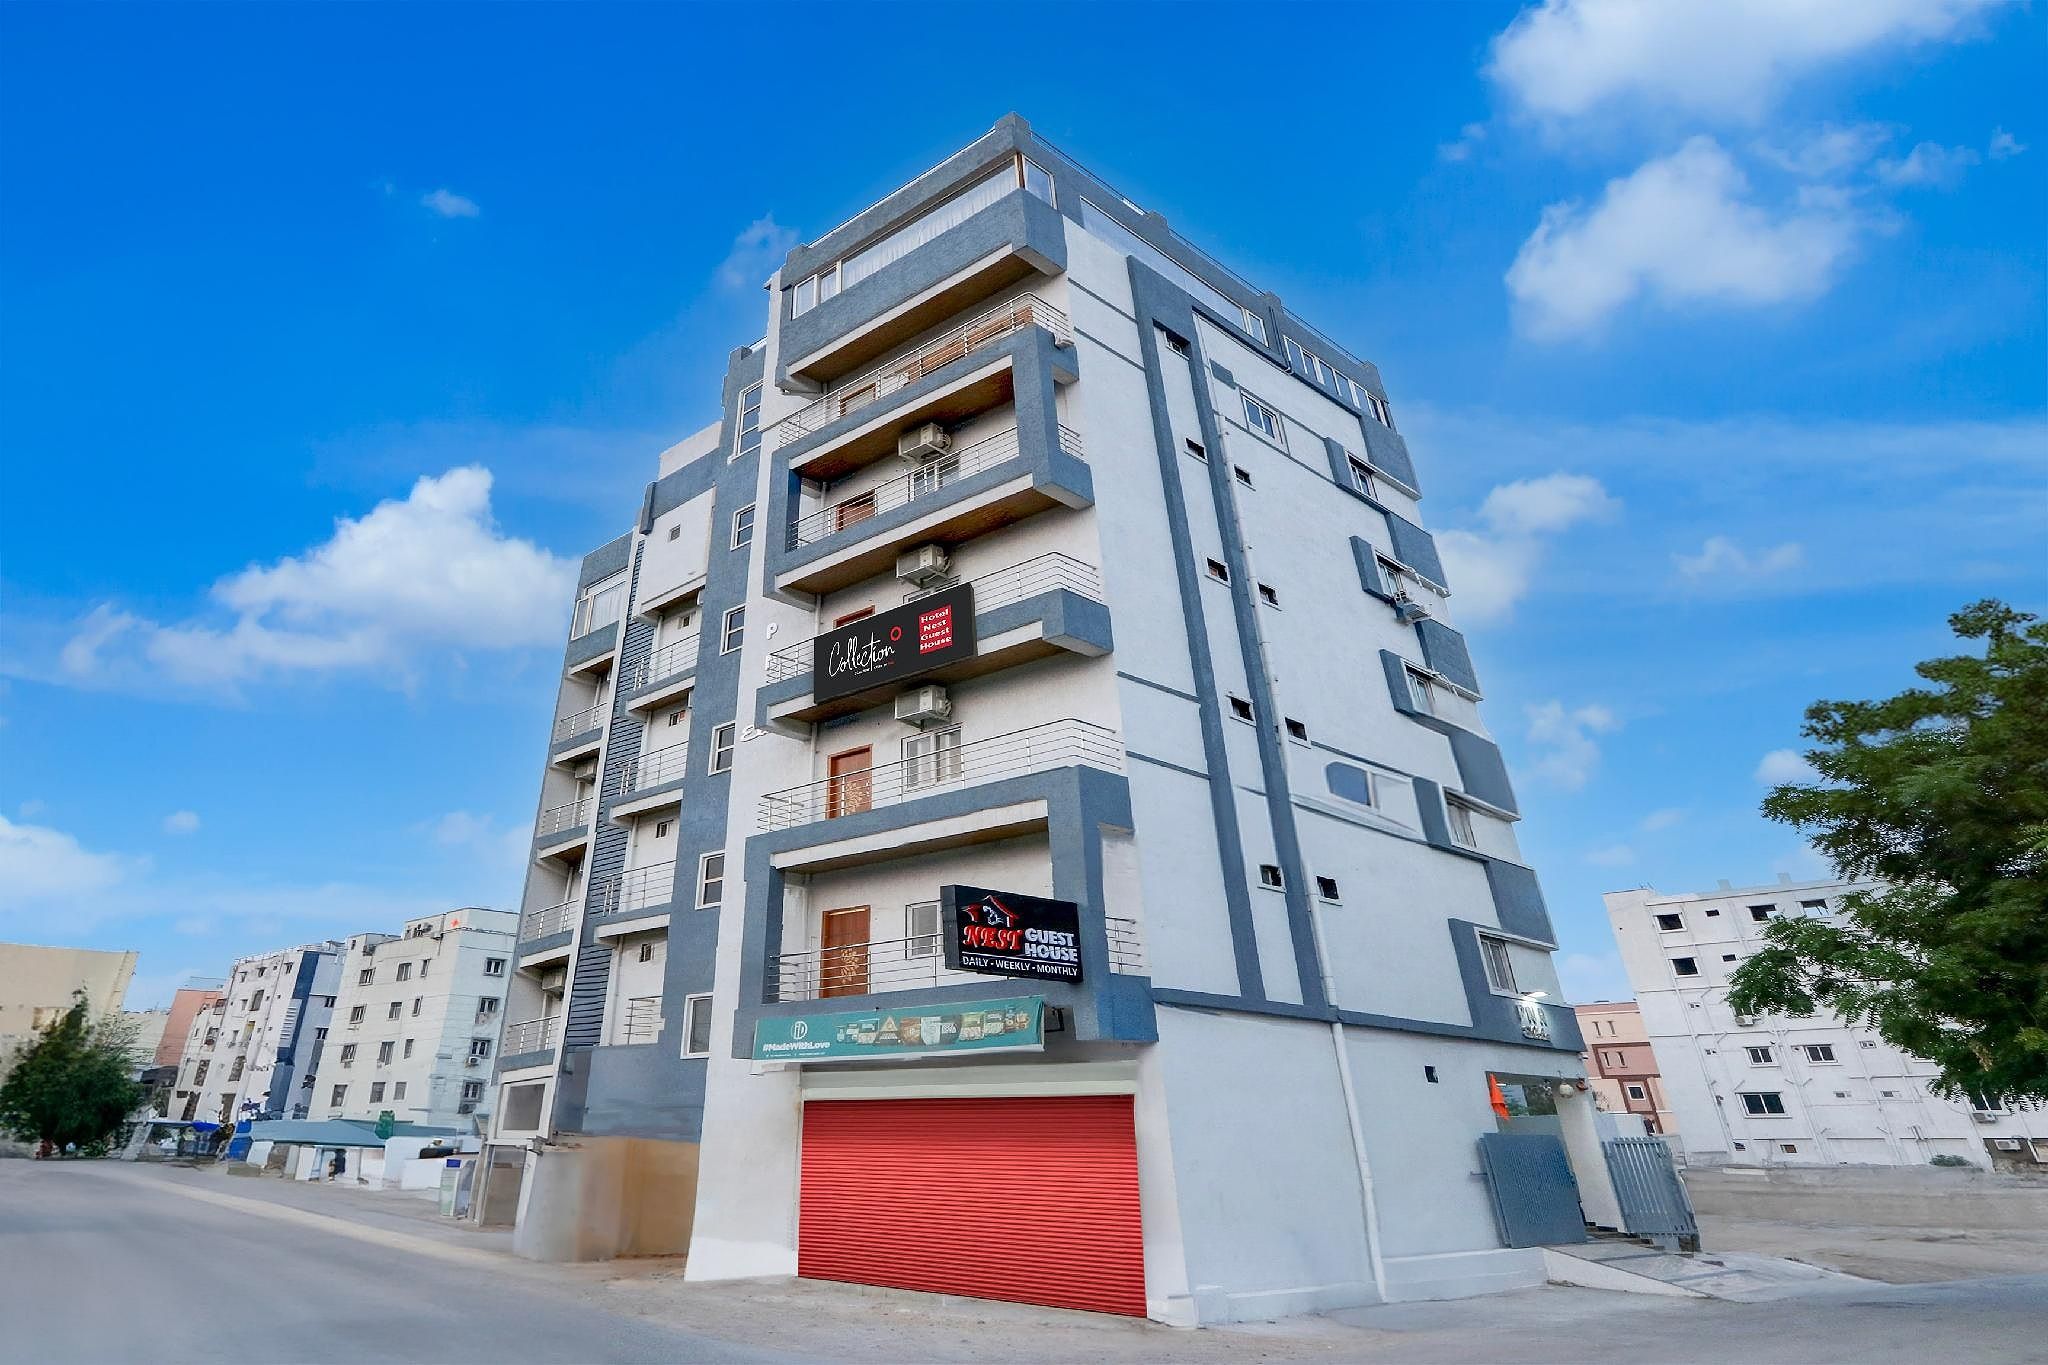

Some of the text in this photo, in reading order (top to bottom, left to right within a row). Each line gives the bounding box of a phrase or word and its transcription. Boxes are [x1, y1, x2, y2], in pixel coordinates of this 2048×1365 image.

[921, 608, 949, 623] Hotel
[920, 627, 950, 641] Guest
[923, 619, 947, 632] Nest
[920, 636, 952, 650] House
[828, 632, 895, 677] Collection
[962, 925, 1024, 950] NEST
[1025, 928, 1075, 946] GUEST
[1025, 942, 1078, 962] HOUSE
[962, 956, 989, 967] DAILY
[995, 960, 1031, 971] WEEKLY
[1036, 964, 1078, 976] MONTHLY
